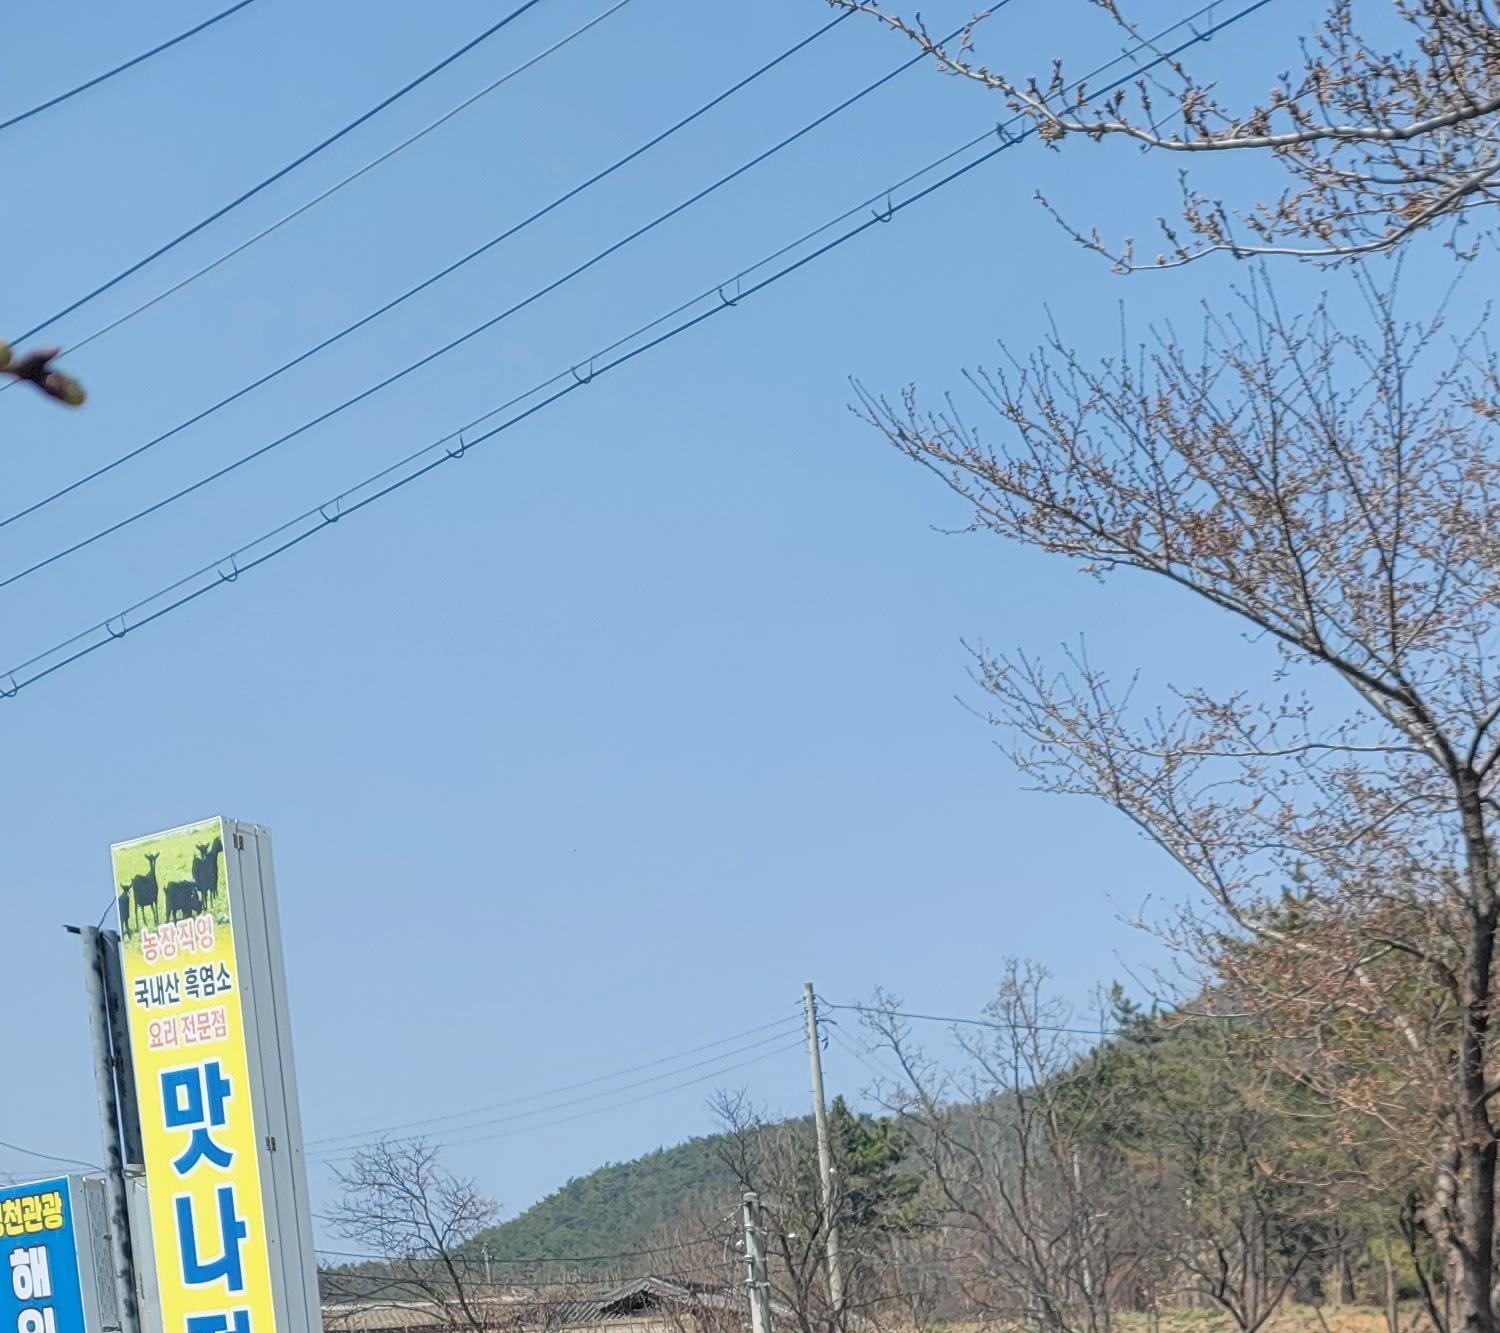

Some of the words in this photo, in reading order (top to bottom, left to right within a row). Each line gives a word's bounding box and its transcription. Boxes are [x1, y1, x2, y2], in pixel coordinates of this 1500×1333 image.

[142, 914, 214, 962] 농장직영
[134, 971, 181, 1008] 국내산
[184, 962, 232, 999] 흑염소
[149, 1018, 178, 1048] 요리
[181, 1007, 227, 1043] 전문점
[0, 1191, 63, 1236] 천관광
